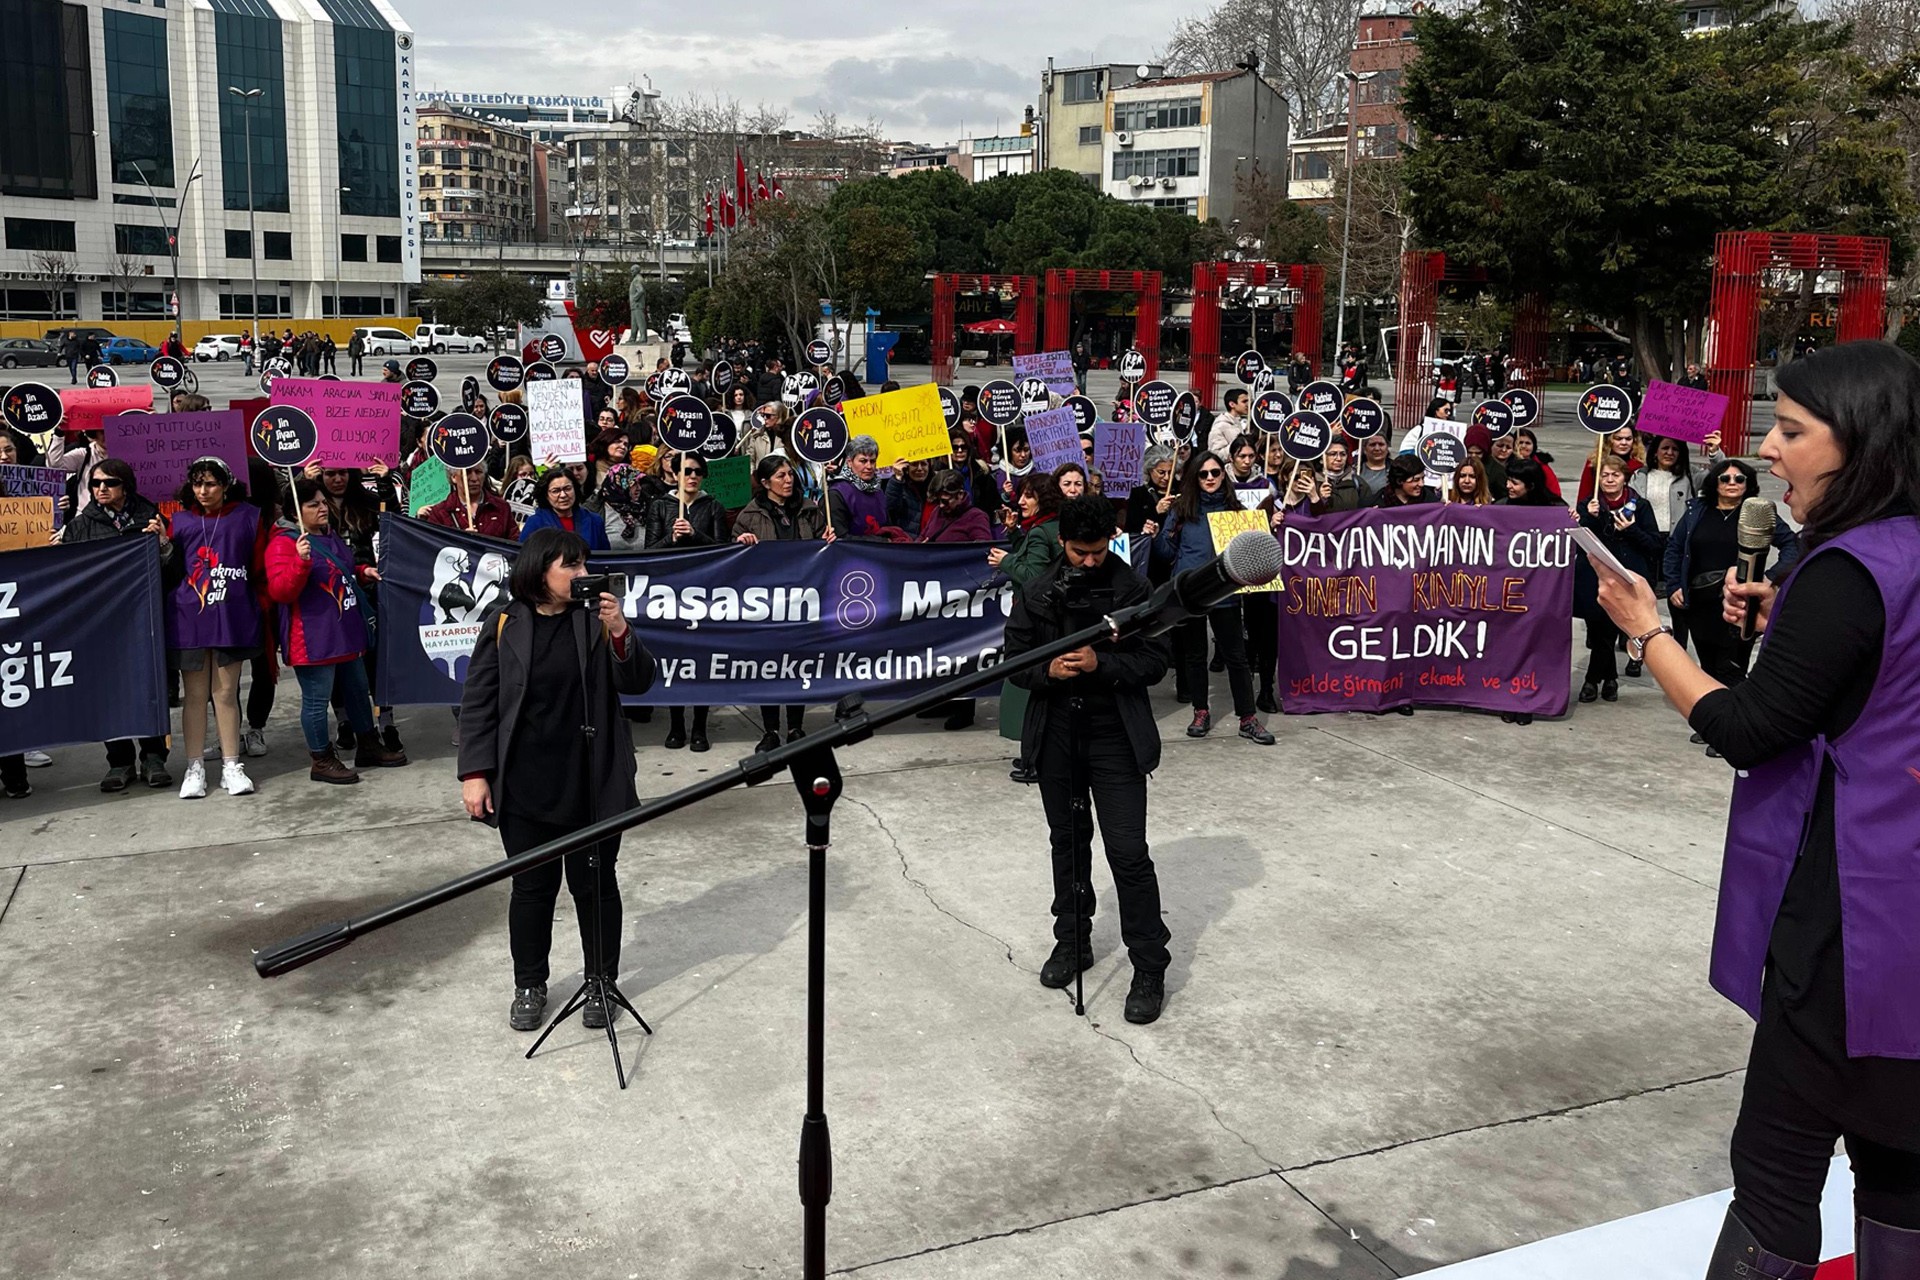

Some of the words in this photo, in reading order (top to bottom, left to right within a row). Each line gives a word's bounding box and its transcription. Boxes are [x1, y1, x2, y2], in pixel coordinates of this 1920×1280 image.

[401, 56, 410, 126] KARTAL
[463, 92, 524, 105] BELEDİYE
[528, 94, 604, 108] BAŞKANLIĞI
[404, 143, 415, 259] BELEDİYESİ
[274, 385, 313, 398] MAKAM
[355, 407, 391, 418] NEDEN
[675, 410, 704, 423] Yaşasın
[852, 400, 884, 419] KADIN
[156, 420, 222, 434] TUTTUĞUN
[678, 429, 697, 439] Mart
[146, 438, 165, 454] BİR
[531, 432, 555, 444] EMEK
[139, 474, 172, 485] İLYON
[1284, 523, 1495, 571] DAYANIŞMANIN
[1508, 528, 1572, 568] GÜCÜ
[210, 563, 248, 581] ekmek
[212, 578, 226, 589] ve
[207, 587, 227, 605] gül
[344, 595, 357, 611] gü
[623, 575, 820, 631] Yaşasın
[836, 571, 877, 631] 8
[901, 579, 1014, 622] Mart
[1286, 574, 1378, 617] SINIFIN
[424, 630, 439, 638] KIZ
[1328, 618, 1487, 662] GELDİK!
[425, 639, 458, 649] HAYATI
[459, 637, 476, 646] YEN
[655, 655, 697, 688] ya
[709, 652, 825, 689] Emekçi
[835, 648, 967, 681] Kadınlar
[1290, 672, 1404, 698] yeldeğirmeni
[1419, 664, 1467, 687] ekmek
[1482, 675, 1501, 690] ve
[1511, 671, 1539, 694] gül
